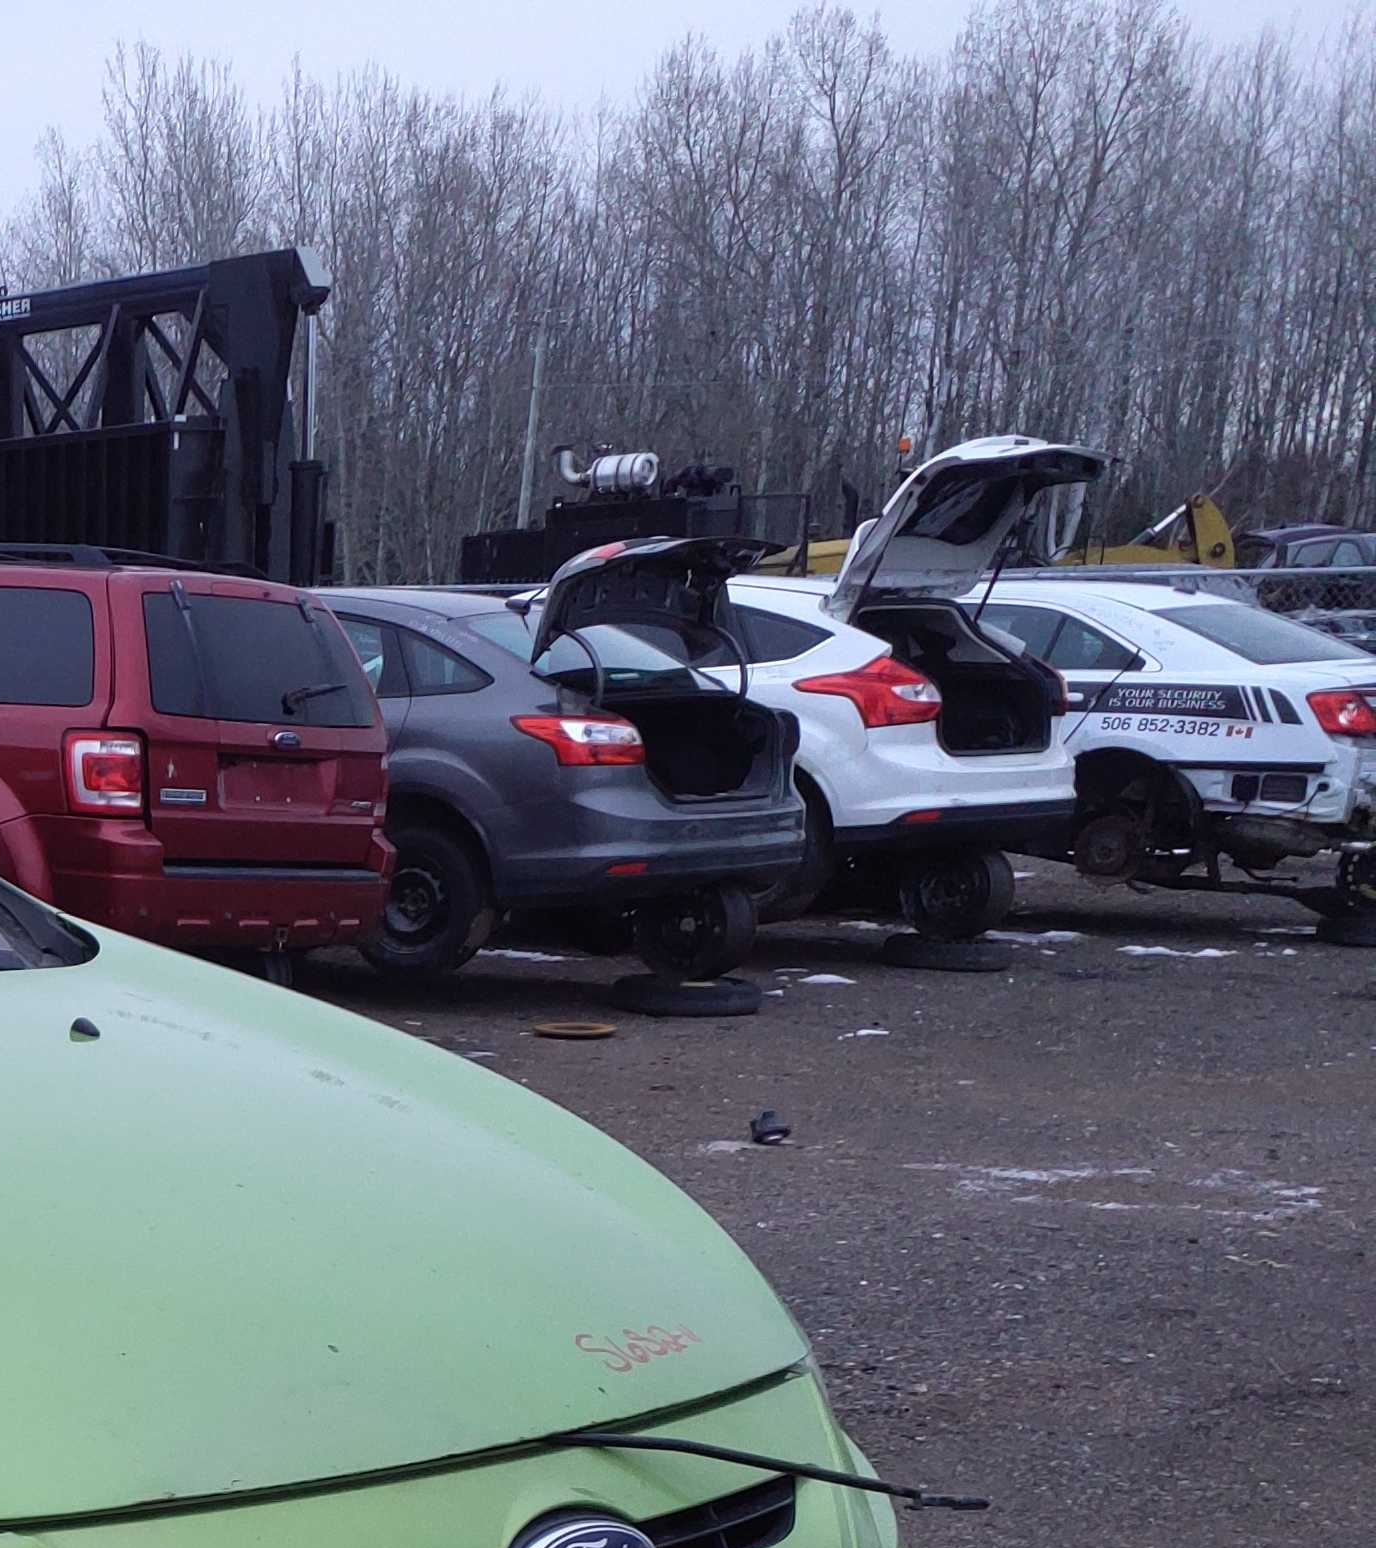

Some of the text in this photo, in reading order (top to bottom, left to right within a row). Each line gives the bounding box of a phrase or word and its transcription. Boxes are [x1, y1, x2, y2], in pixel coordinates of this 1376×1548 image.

[1117, 688, 1154, 698] YOUR
[1125, 698, 1154, 708] OUR
[1100, 716, 1221, 737] 506 852-3382
